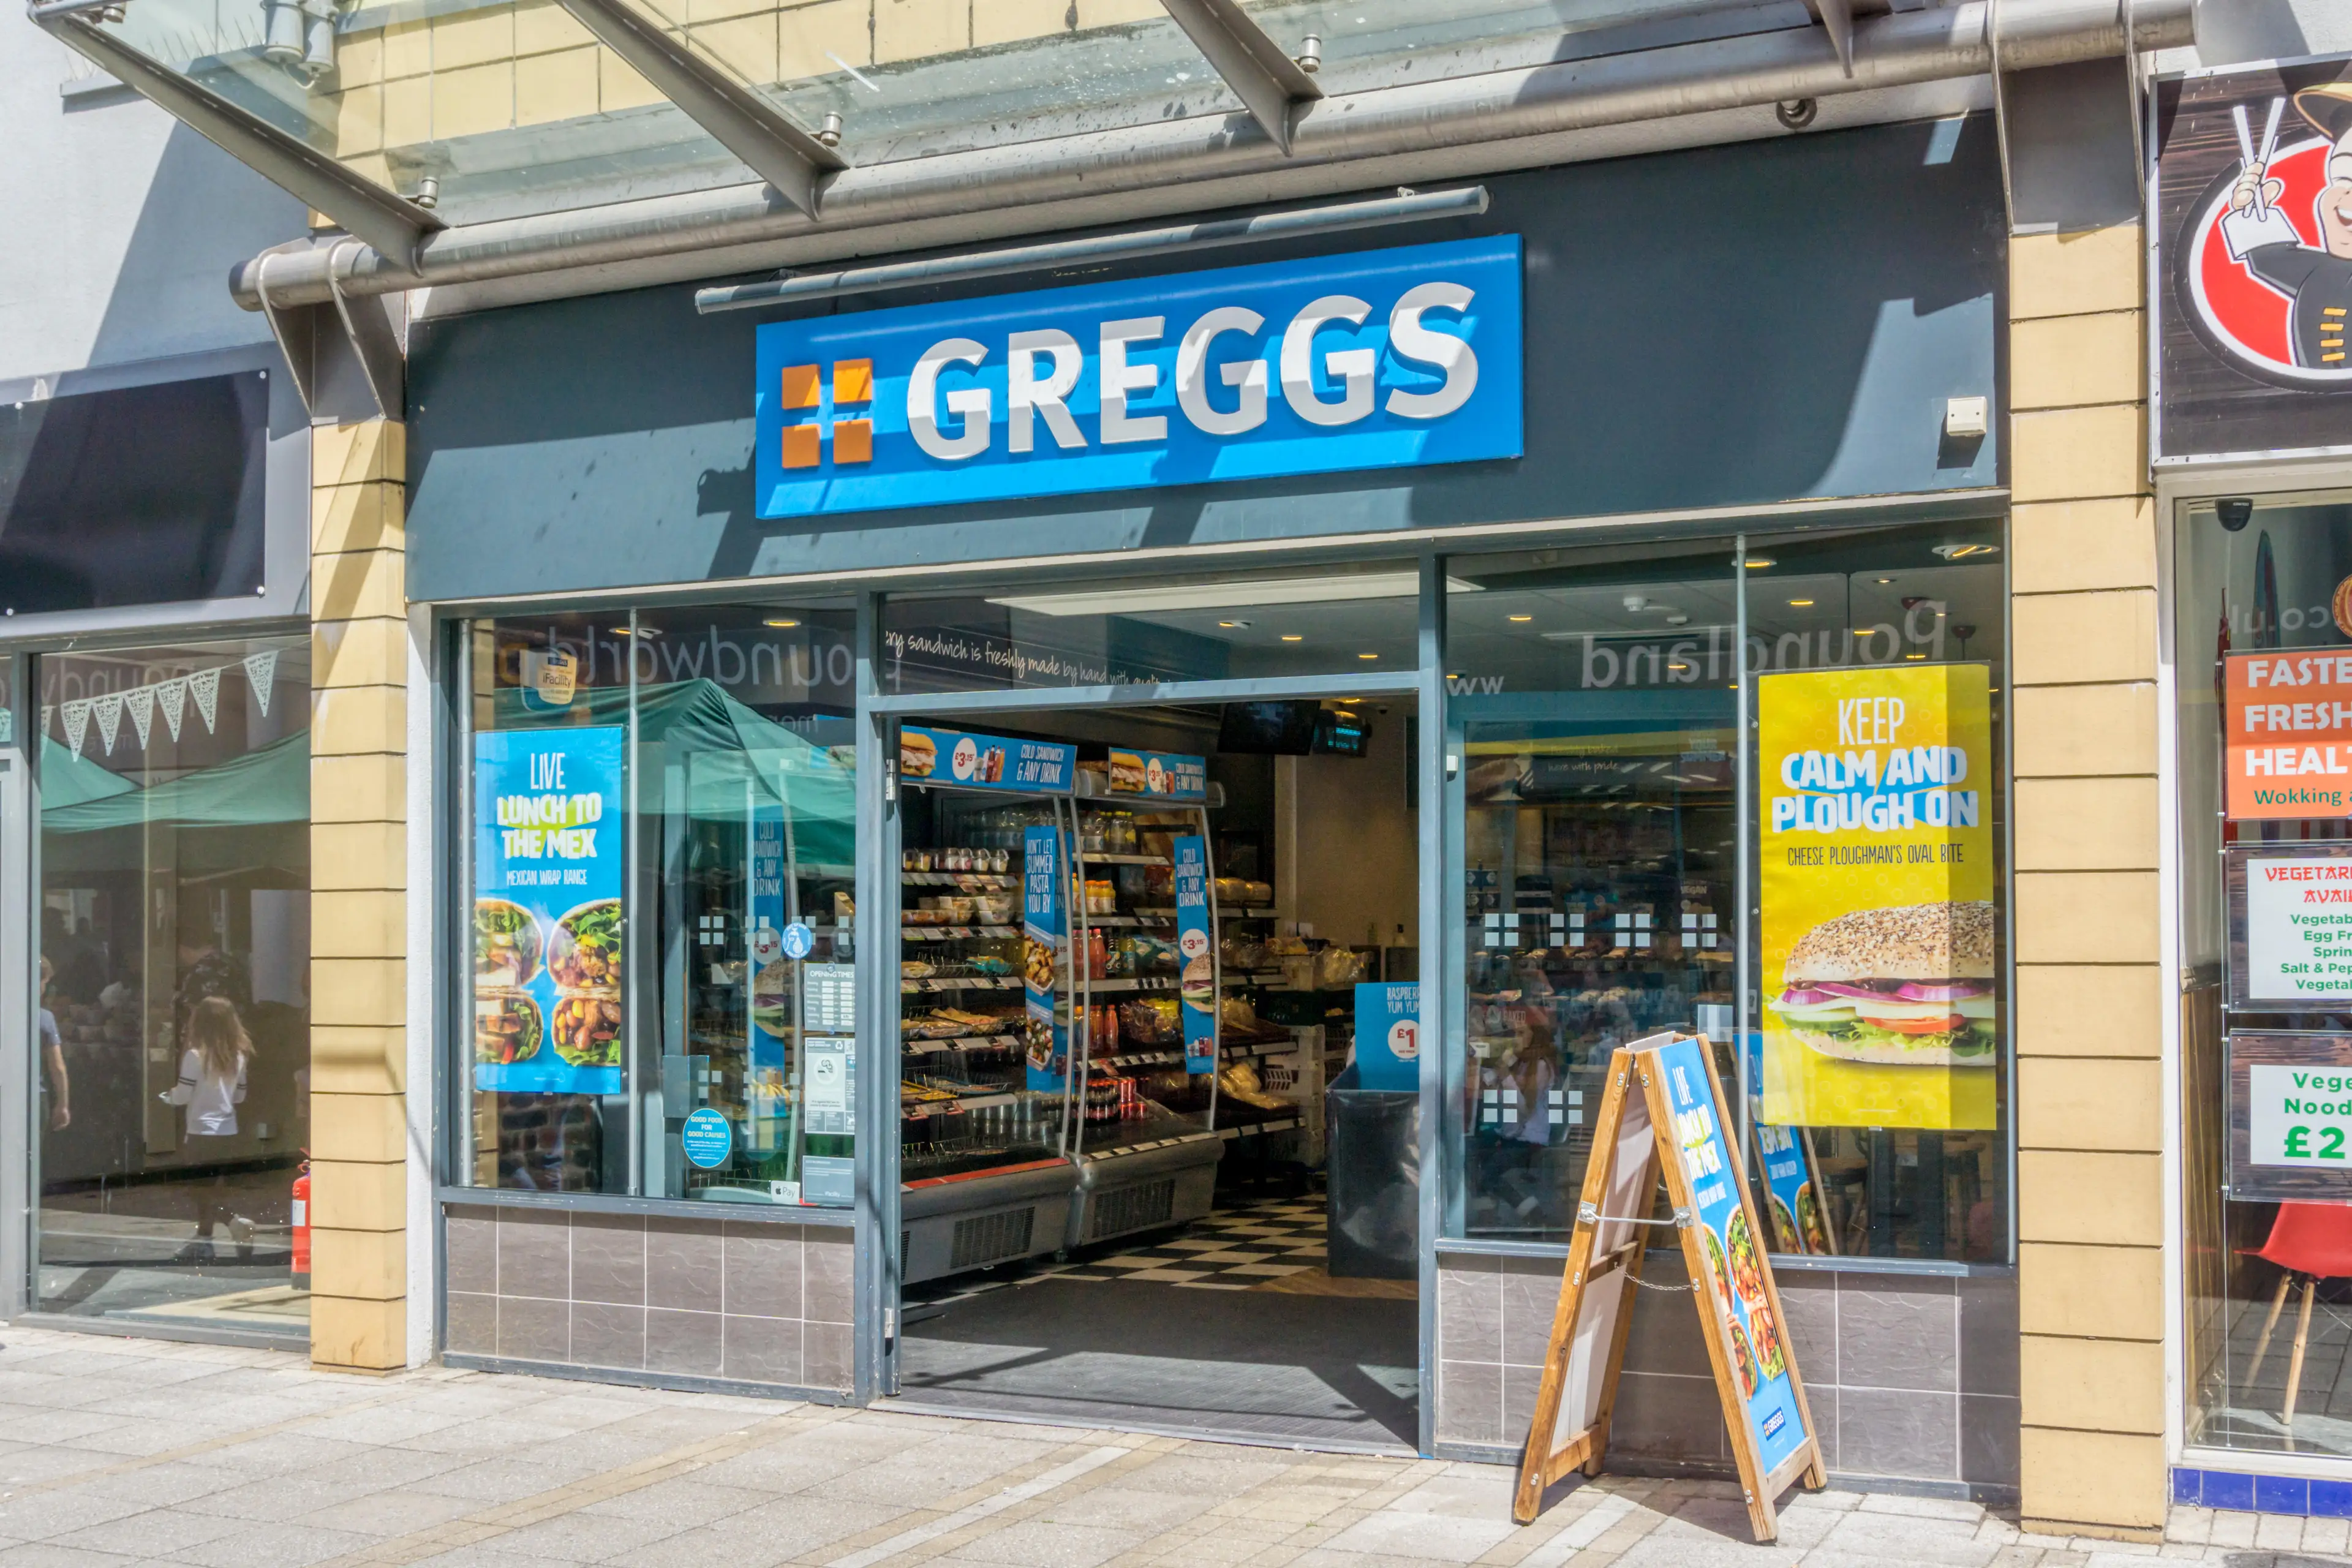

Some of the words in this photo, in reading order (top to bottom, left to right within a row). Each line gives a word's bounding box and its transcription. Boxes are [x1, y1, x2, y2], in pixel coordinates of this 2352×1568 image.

[907, 281, 1479, 461] GREGGS
[908, 633, 968, 660] sandwich
[971, 642, 982, 662] is
[985, 641, 1026, 679] freshly
[1028, 655, 1061, 676] made
[1063, 660, 1078, 687] by
[1080, 662, 1107, 684] hand
[1110, 670, 1129, 685] with
[542, 672, 572, 688] iFacility
[2248, 657, 2352, 688] FASTE
[1838, 697, 1905, 745] KEEP
[2244, 701, 2352, 733] FRESH
[1021, 744, 1035, 759] COLD
[1036, 745, 1065, 762] SANDWICH
[2245, 746, 2352, 777] HEAL
[530, 752, 566, 790] LIVE
[1017, 763, 1023, 781] &
[1023, 761, 1041, 783] ANY
[1040, 762, 1062, 785] DRINK
[1781, 749, 1877, 790] CALM
[1886, 745, 1967, 786] AND
[2254, 788, 2342, 807] Wokking
[497, 793, 567, 826] LUNCH
[572, 792, 603, 824] TO
[1772, 792, 1915, 834] PLOUGH
[1925, 790, 1978, 827] ON
[759, 821, 774, 840] COLD
[501, 829, 542, 859] THE
[546, 828, 598, 859] MEX
[753, 840, 782, 858] ANDWICH
[1027, 839, 1042, 854] DON'T
[1042, 839, 1053, 854] LET
[1183, 848, 1196, 862] COLD
[1788, 846, 1824, 866] CHEESE
[1830, 845, 1902, 865] PLOUGHMAN'S
[1908, 844, 1935, 863] OVAL
[1940, 843, 1964, 863] BITE
[764, 859, 777, 877] ANY
[1027, 855, 1053, 874] SUMMER
[1177, 862, 1204, 878] SANDWICH
[507, 870, 537, 886] MEXICAN
[540, 869, 562, 885] WRAP
[564, 869, 588, 885] RANGE
[1030, 875, 1049, 893] PASTA
[1188, 877, 1199, 892] ANY
[753, 878, 782, 897] DRINK
[1028, 894, 1041, 913] YOU
[1042, 894, 1051, 913] BY
[1178, 892, 1205, 907] DRINK
[2290, 913, 2352, 927] Vegetab
[2304, 930, 2332, 943] Egg
[2313, 946, 2352, 959] Sprin
[2280, 962, 2309, 974] Salt
[2313, 962, 2324, 974] &
[1387, 1001, 1403, 1014] YUM
[1397, 1028, 1415, 1047] £1
[2292, 1072, 2352, 1093] Vege
[2284, 1098, 2352, 1116] Nood
[2284, 1125, 2346, 1159] £2
[782, 1186, 796, 1199] Pay
